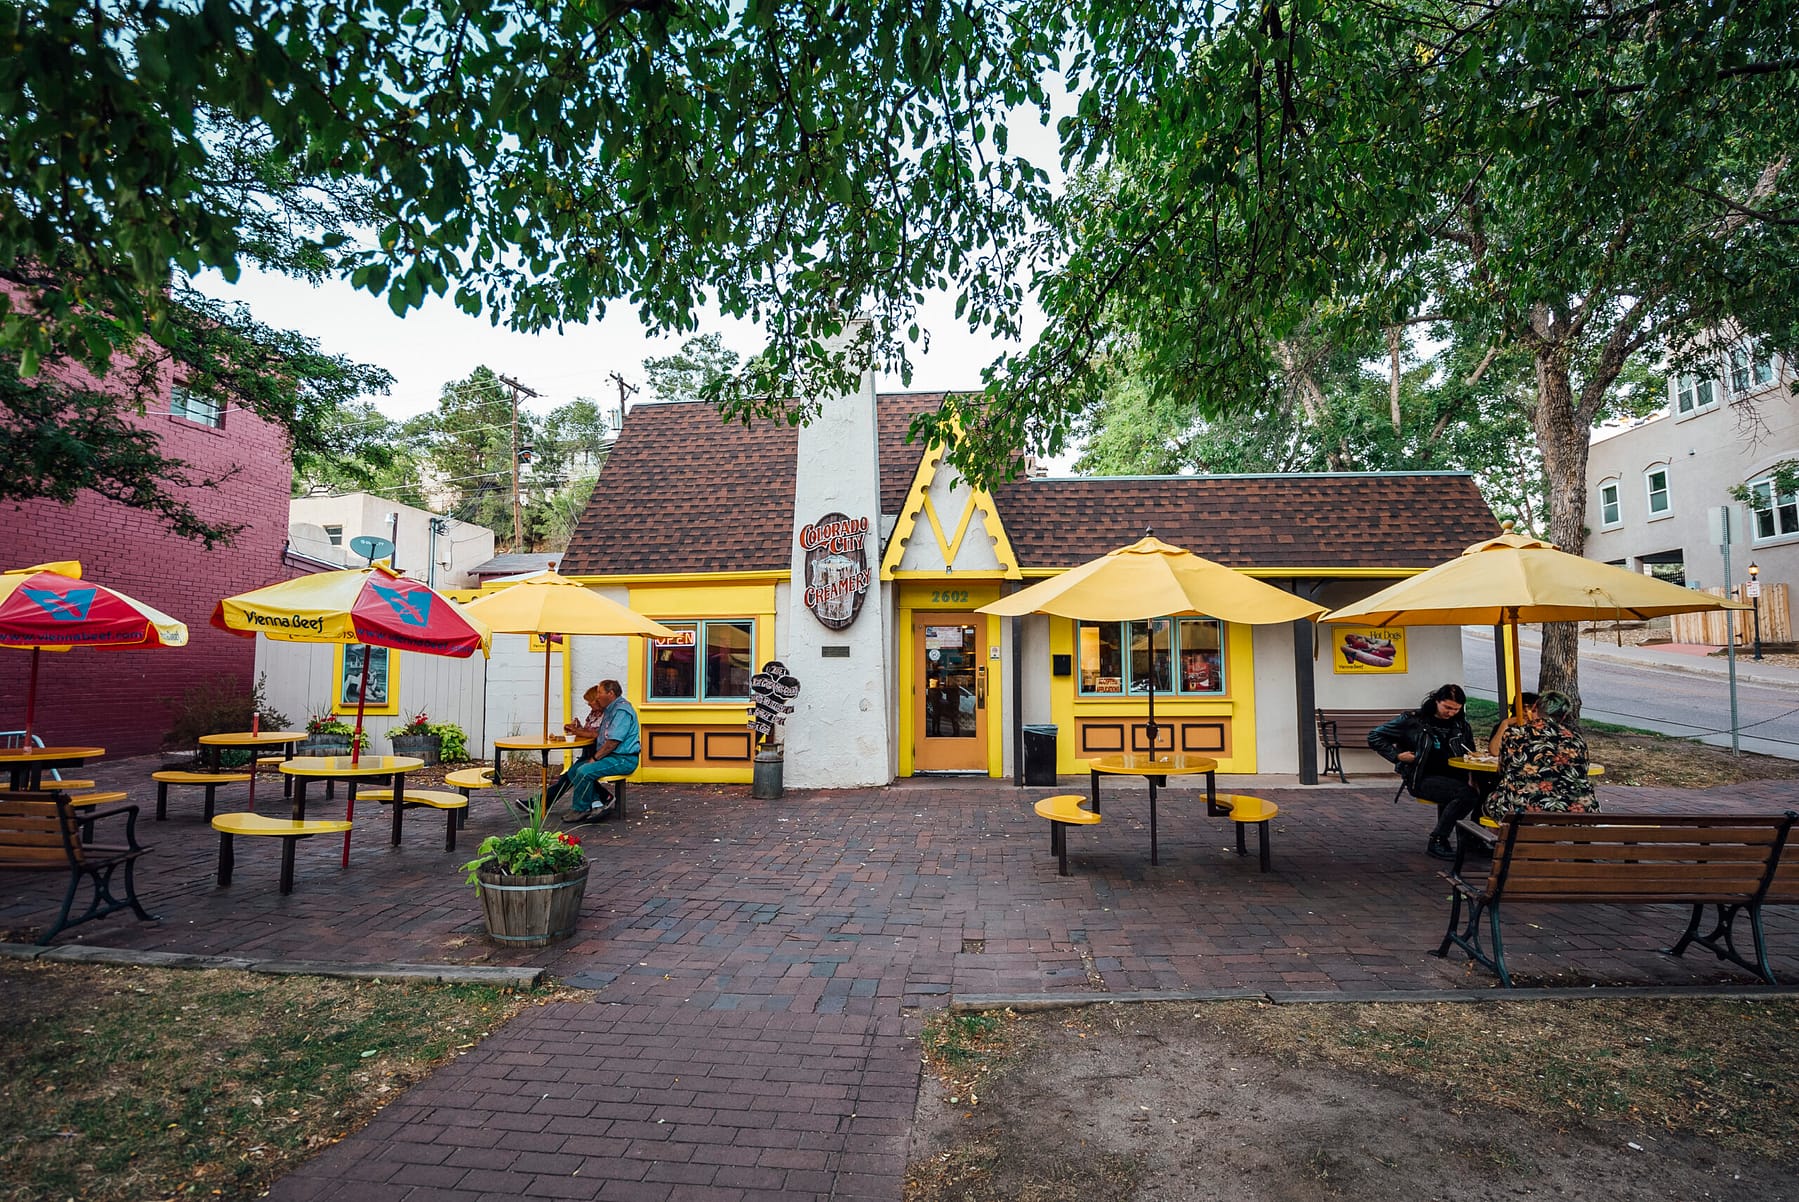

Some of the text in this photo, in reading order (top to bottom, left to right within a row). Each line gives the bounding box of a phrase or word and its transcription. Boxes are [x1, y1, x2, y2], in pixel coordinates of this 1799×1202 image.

[800, 516, 868, 551] COLORADO
[829, 532, 865, 555] CITY
[803, 567, 872, 609] CREAMERY
[931, 590, 969, 603] 2602
[243, 609, 324, 634] Vienna Beef
[1369, 631, 1402, 641] Hot Dogs
